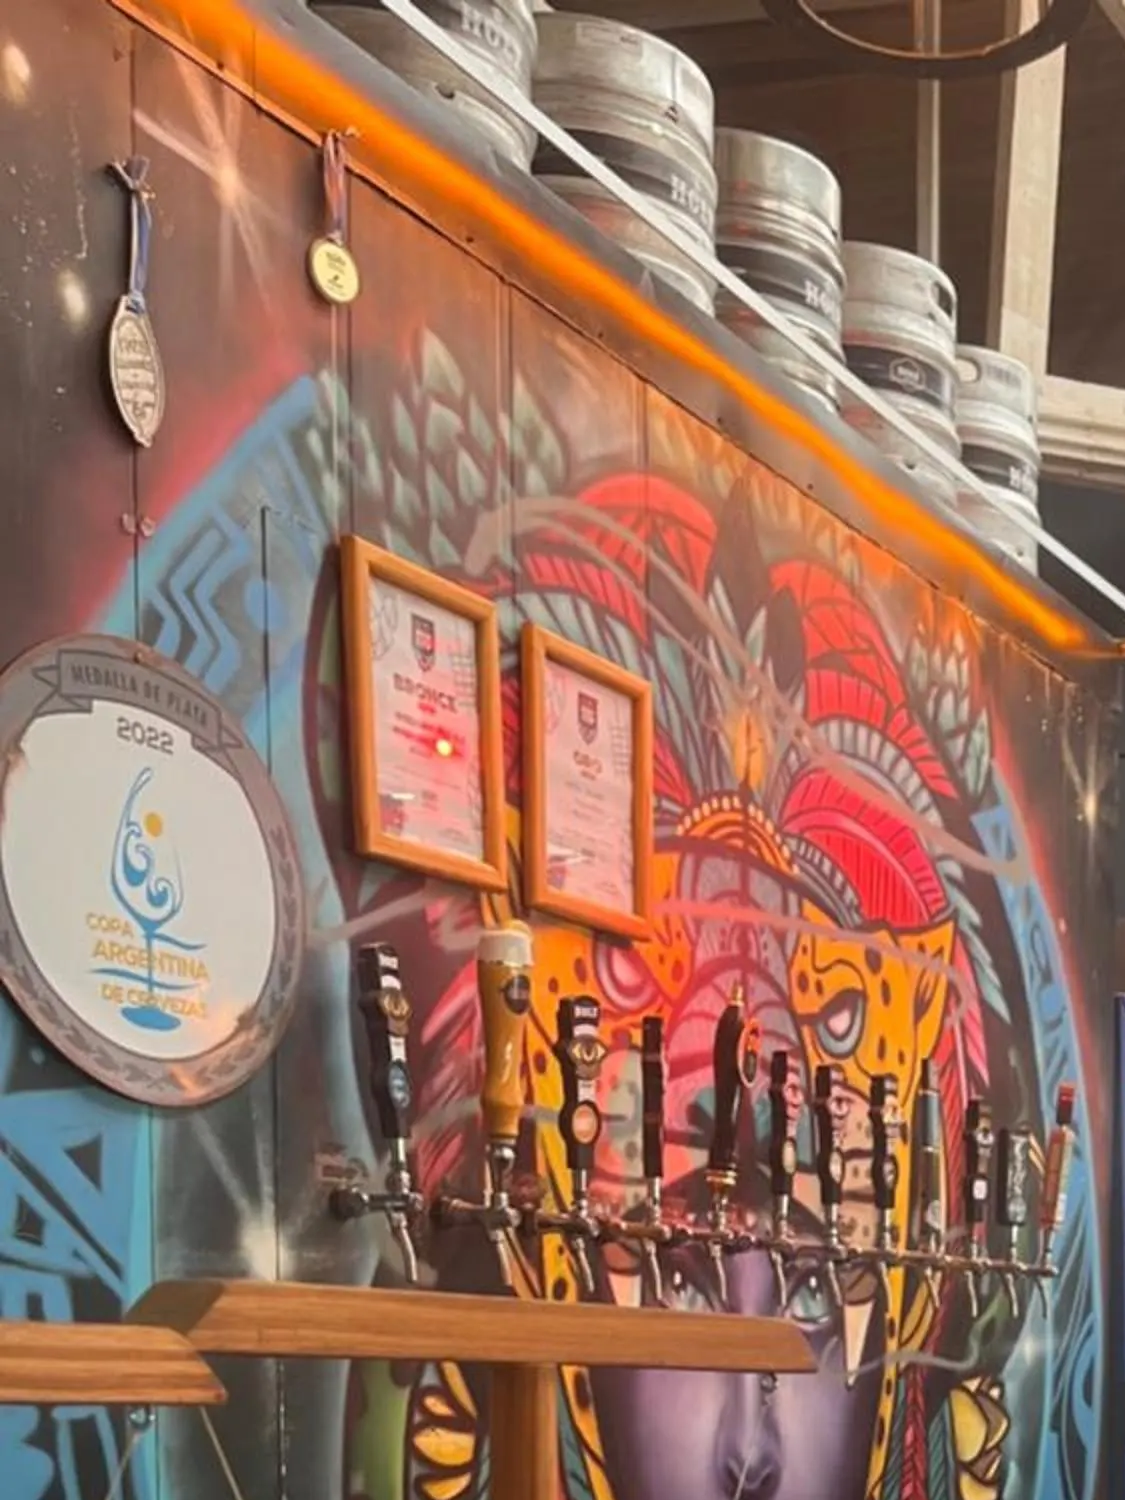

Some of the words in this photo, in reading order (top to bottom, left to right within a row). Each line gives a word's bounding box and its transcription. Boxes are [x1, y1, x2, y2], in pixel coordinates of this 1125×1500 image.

[70, 663, 138, 693] MEDALLA
[144, 680, 160, 703] DE
[168, 690, 207, 727] PLATA
[116, 716, 174, 755] 2022
[86, 913, 134, 939] COPA
[93, 940, 211, 982] ARGENTINA
[102, 983, 124, 1004] DE
